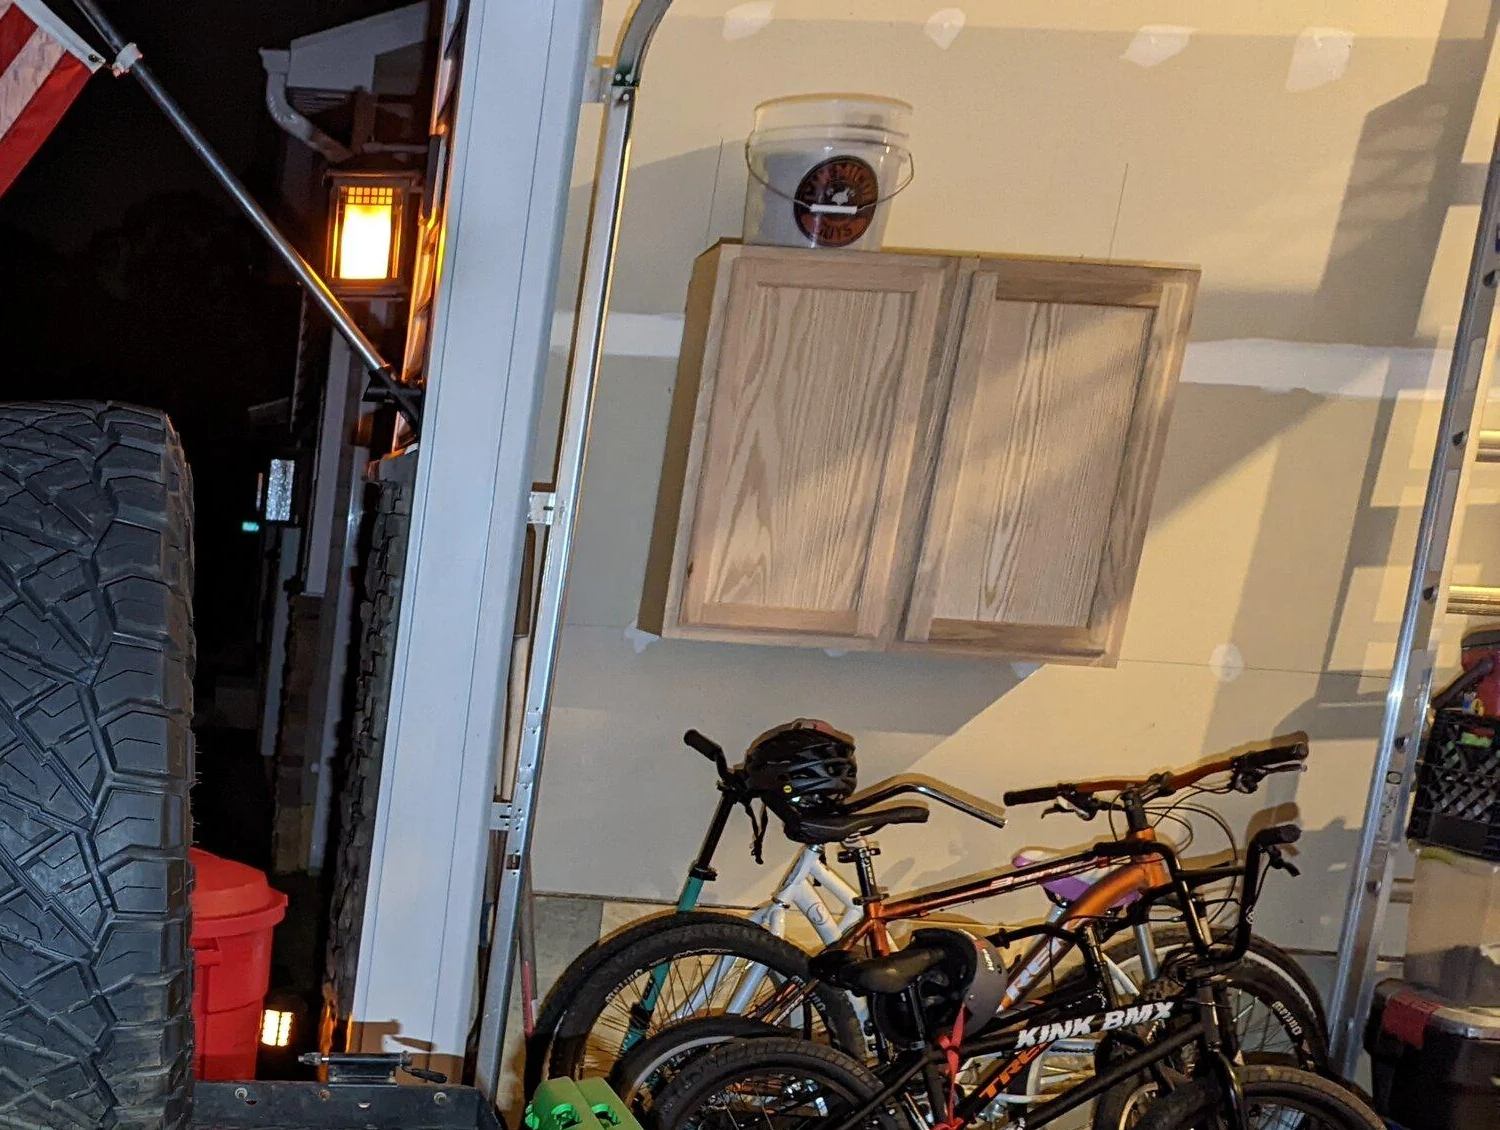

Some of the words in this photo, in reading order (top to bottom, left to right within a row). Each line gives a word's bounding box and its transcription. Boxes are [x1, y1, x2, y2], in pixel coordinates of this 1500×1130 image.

[1014, 1014, 1096, 1050] KINK
[1102, 1001, 1175, 1030] BMX
[978, 1040, 1047, 1099] TRE
